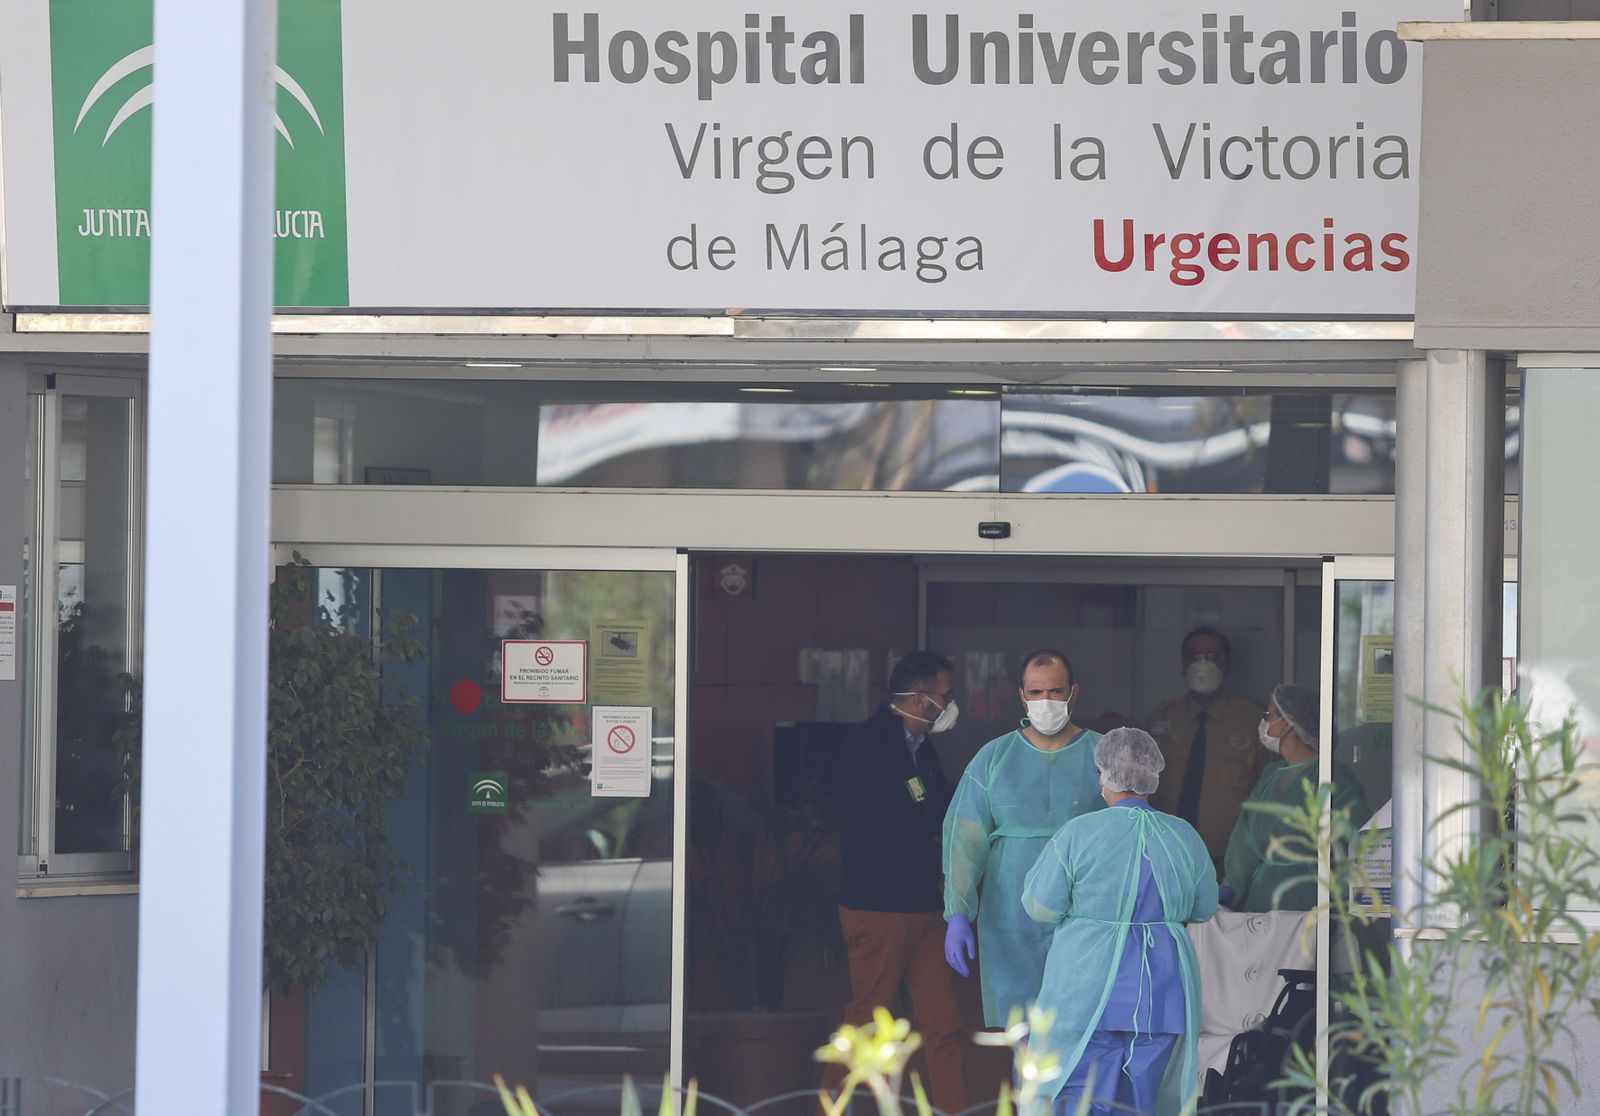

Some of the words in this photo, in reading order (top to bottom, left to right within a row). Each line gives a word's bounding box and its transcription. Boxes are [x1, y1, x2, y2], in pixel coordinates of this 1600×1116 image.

[553, 13, 864, 100] Hospital
[912, 12, 1408, 85] Universitario
[665, 123, 875, 194] Virgen
[923, 123, 1004, 181] de
[1053, 123, 1107, 181] la
[1152, 122, 1410, 181] Victoria
[79, 208, 151, 237] JUNTA
[667, 223, 735, 271] de
[766, 223, 984, 283] Málaga
[1093, 218, 1410, 286] Urgencias
